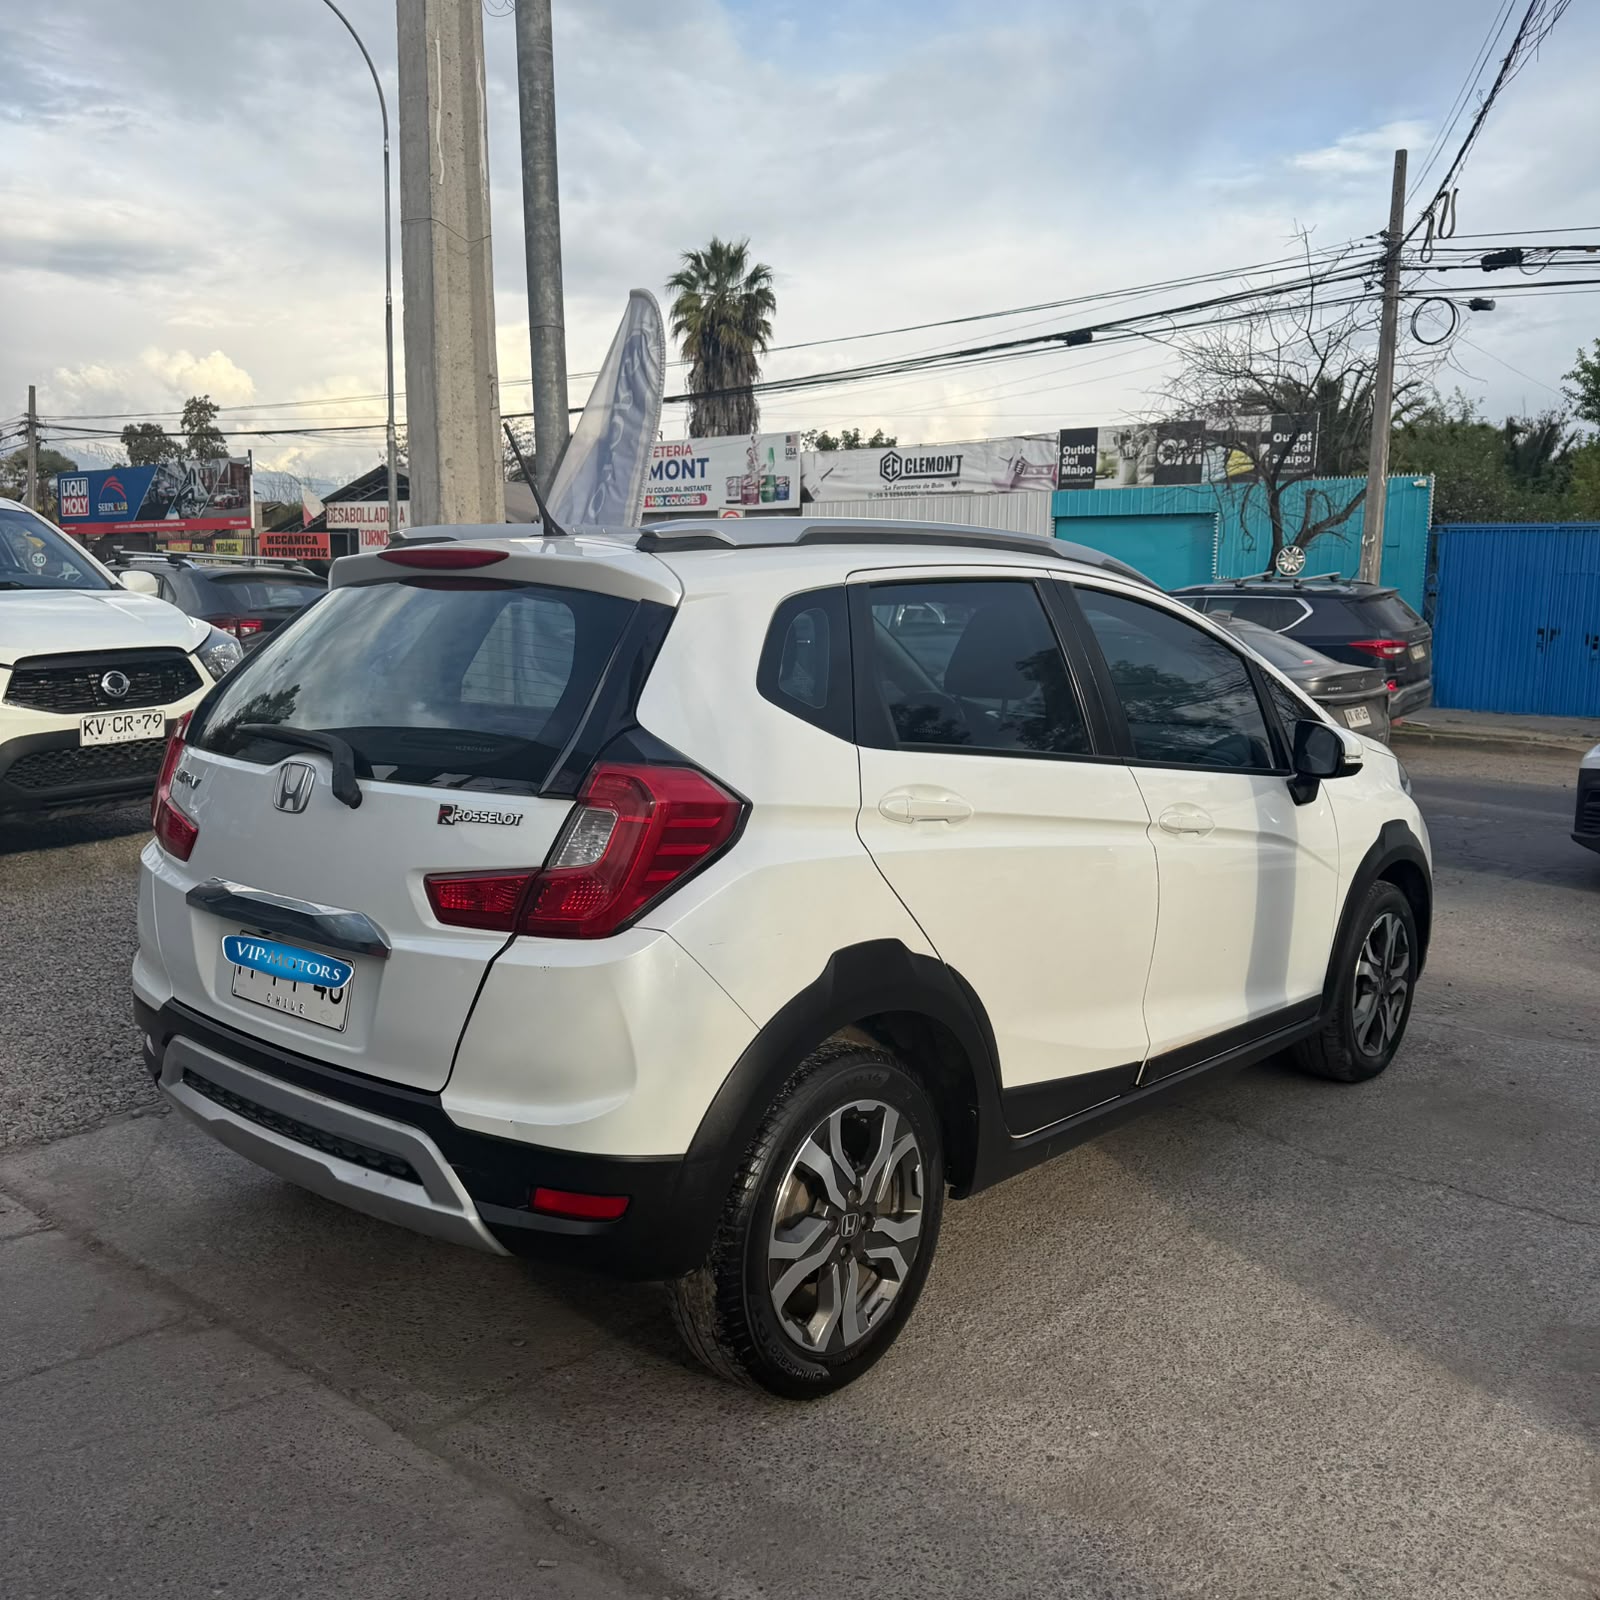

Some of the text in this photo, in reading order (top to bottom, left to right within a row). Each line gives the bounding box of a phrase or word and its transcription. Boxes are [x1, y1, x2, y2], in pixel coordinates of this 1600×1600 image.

[1273, 431, 1313, 443] Ouet
[785, 447, 797, 456] USA
[1063, 445, 1096, 455] Outlet
[1063, 456, 1079, 465] del
[1062, 465, 1094, 477] Maipo
[62, 481, 87, 497] LIQUI
[683, 484, 712, 492] INSTANTE
[665, 495, 701, 505] COLORES
[63, 498, 88, 514] MOLY
[327, 506, 405, 523] DESABOLLADA
[261, 547, 328, 557] AUTOMOTRIZ
[265, 992, 305, 1015] CHILE
